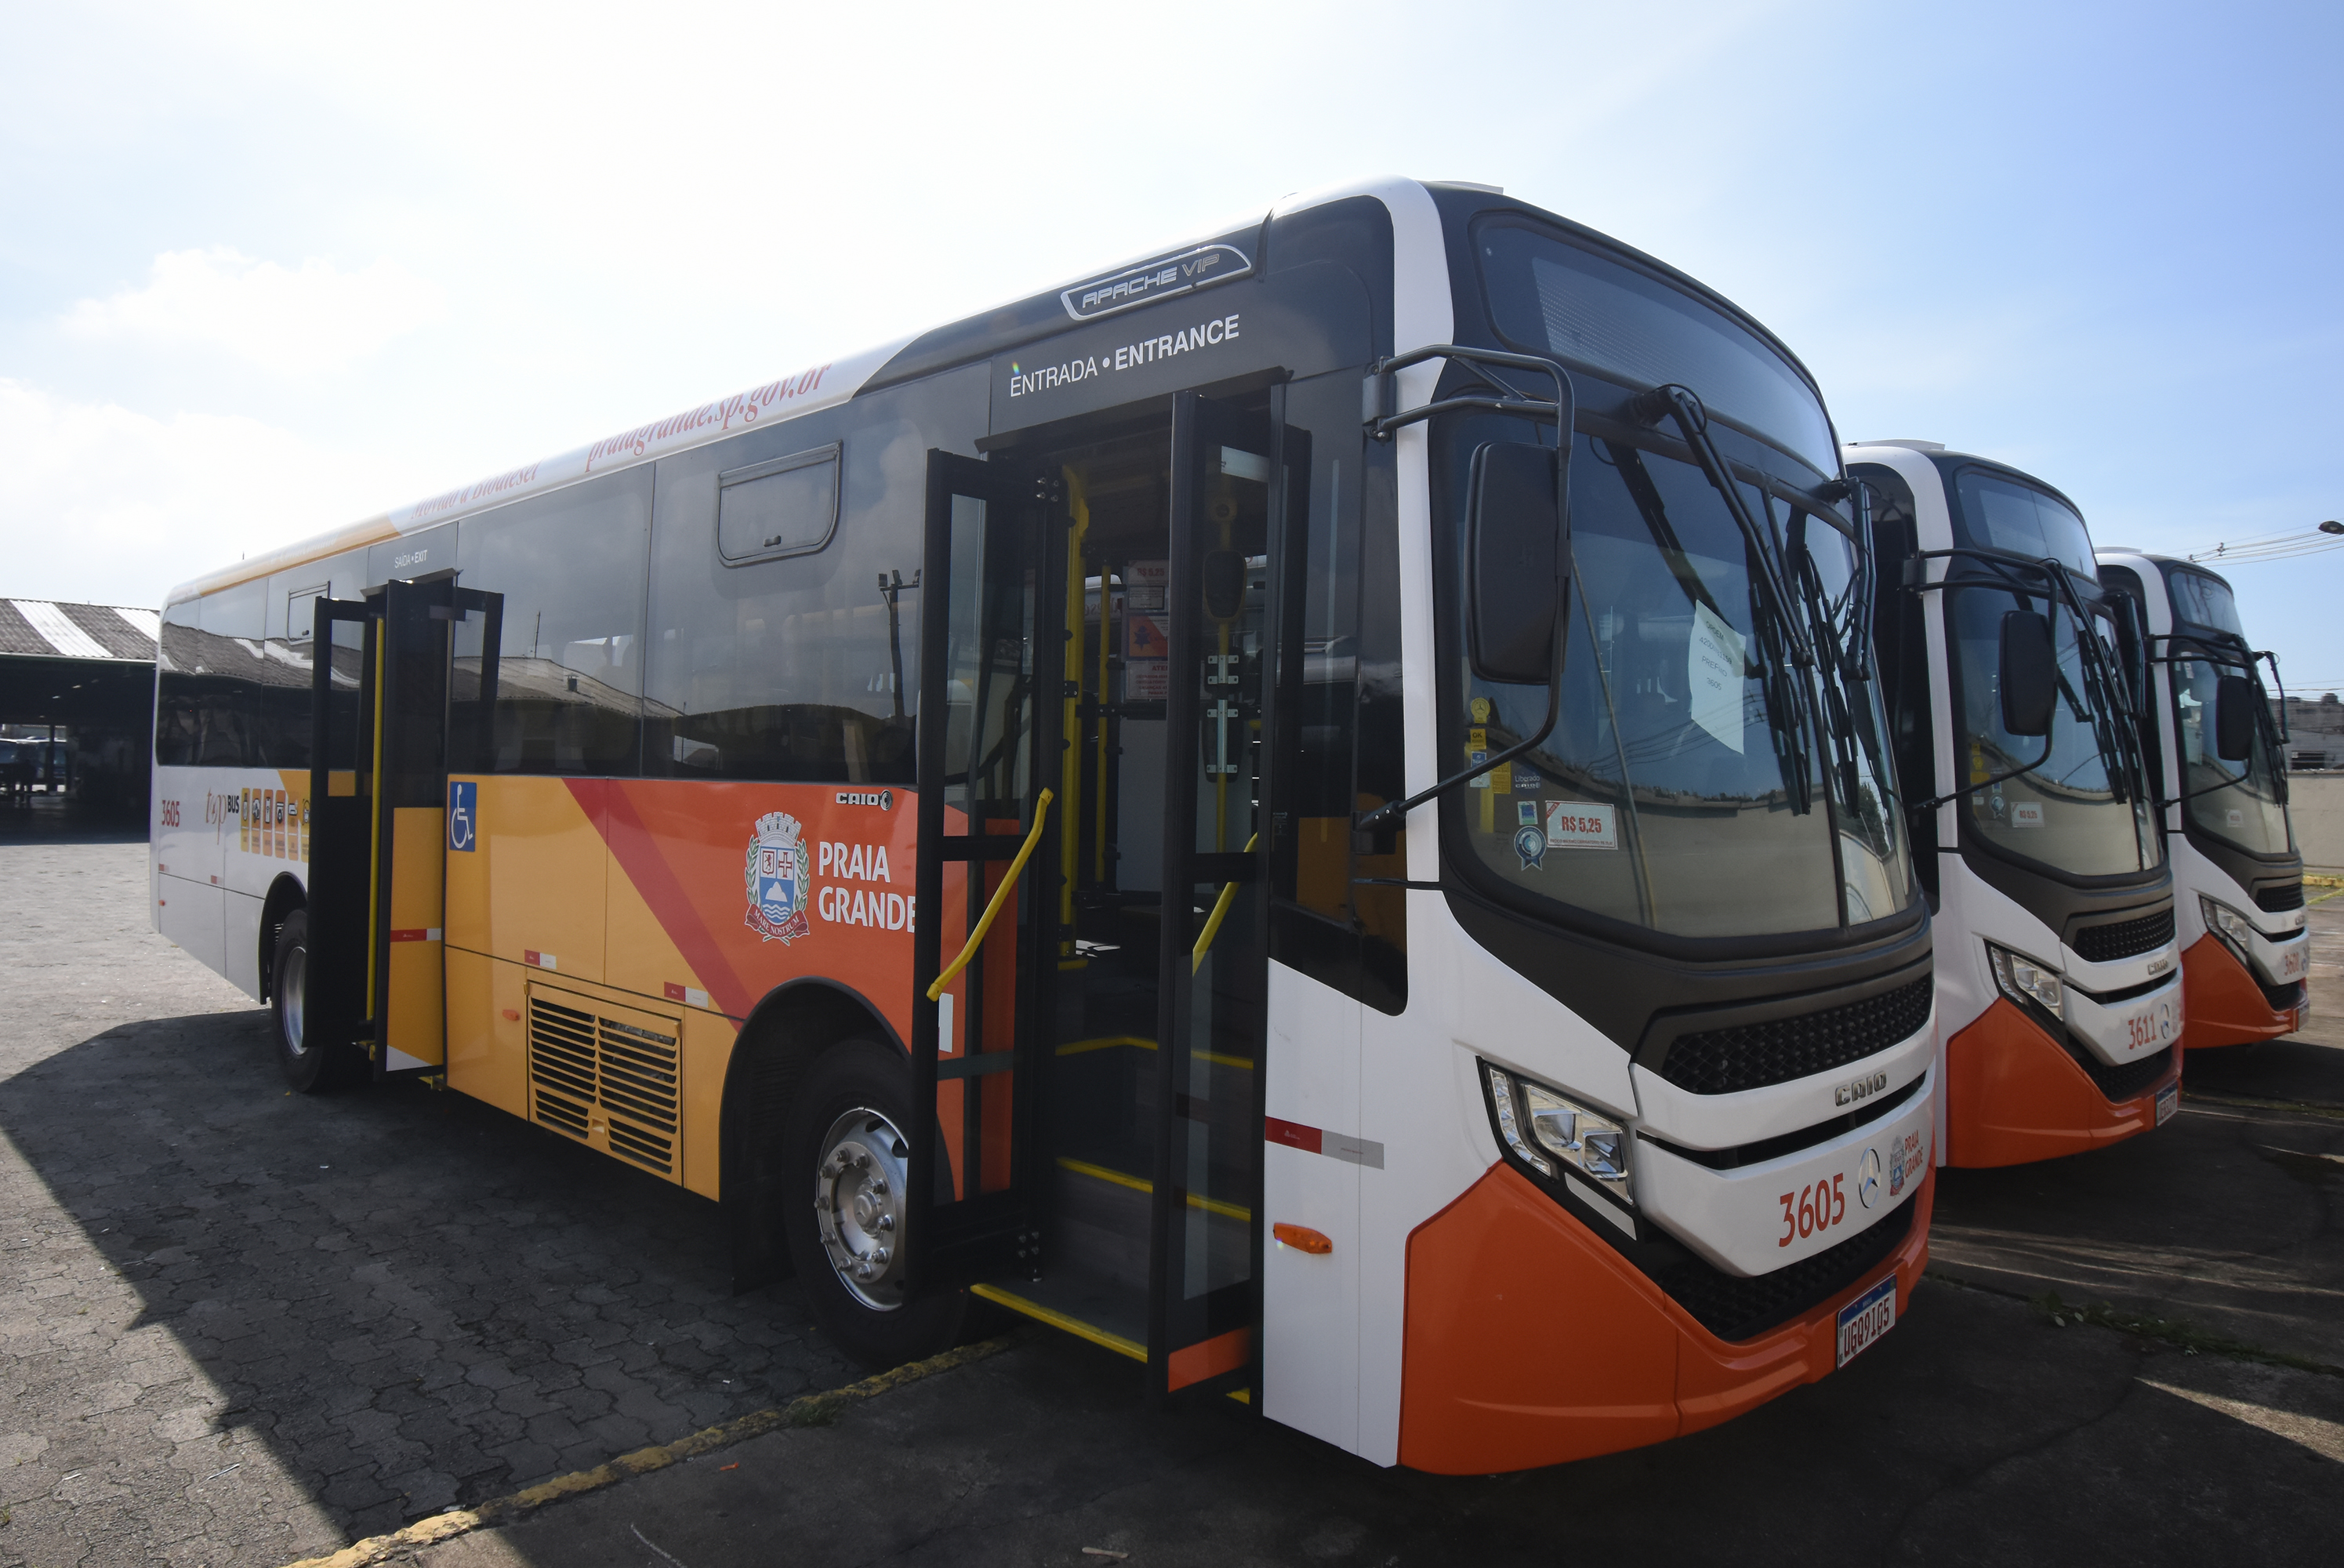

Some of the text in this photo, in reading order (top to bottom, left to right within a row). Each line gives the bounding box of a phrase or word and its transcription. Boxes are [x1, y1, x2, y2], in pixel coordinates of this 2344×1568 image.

[1082, 253, 1220, 308] APACHE VIP
[1010, 314, 1239, 397] ENTRADA ENTRANCE
[585, 361, 833, 473] praiagrande.sp.gov.br
[394, 549, 427, 569] SAÍDA EXIT
[1705, 621, 1725, 641] ORDEM
[1707, 677, 1722, 691] 3605
[161, 800, 180, 827] 3605
[227, 794, 240, 814] BUS
[836, 792, 880, 806] CAIO
[1562, 816, 1602, 834] R$ 5,25
[818, 841, 891, 884] PRAIA
[754, 909, 800, 935] MARE NOSTRUM
[818, 886, 916, 933] GRANDE
[2128, 1012, 2157, 1050] 3611
[1834, 1070, 1887, 1108] CAIO
[1905, 1129, 1919, 1157] PRAIA
[1905, 1146, 1923, 1178] GRANDE
[1778, 1172, 1845, 1248] 3605
